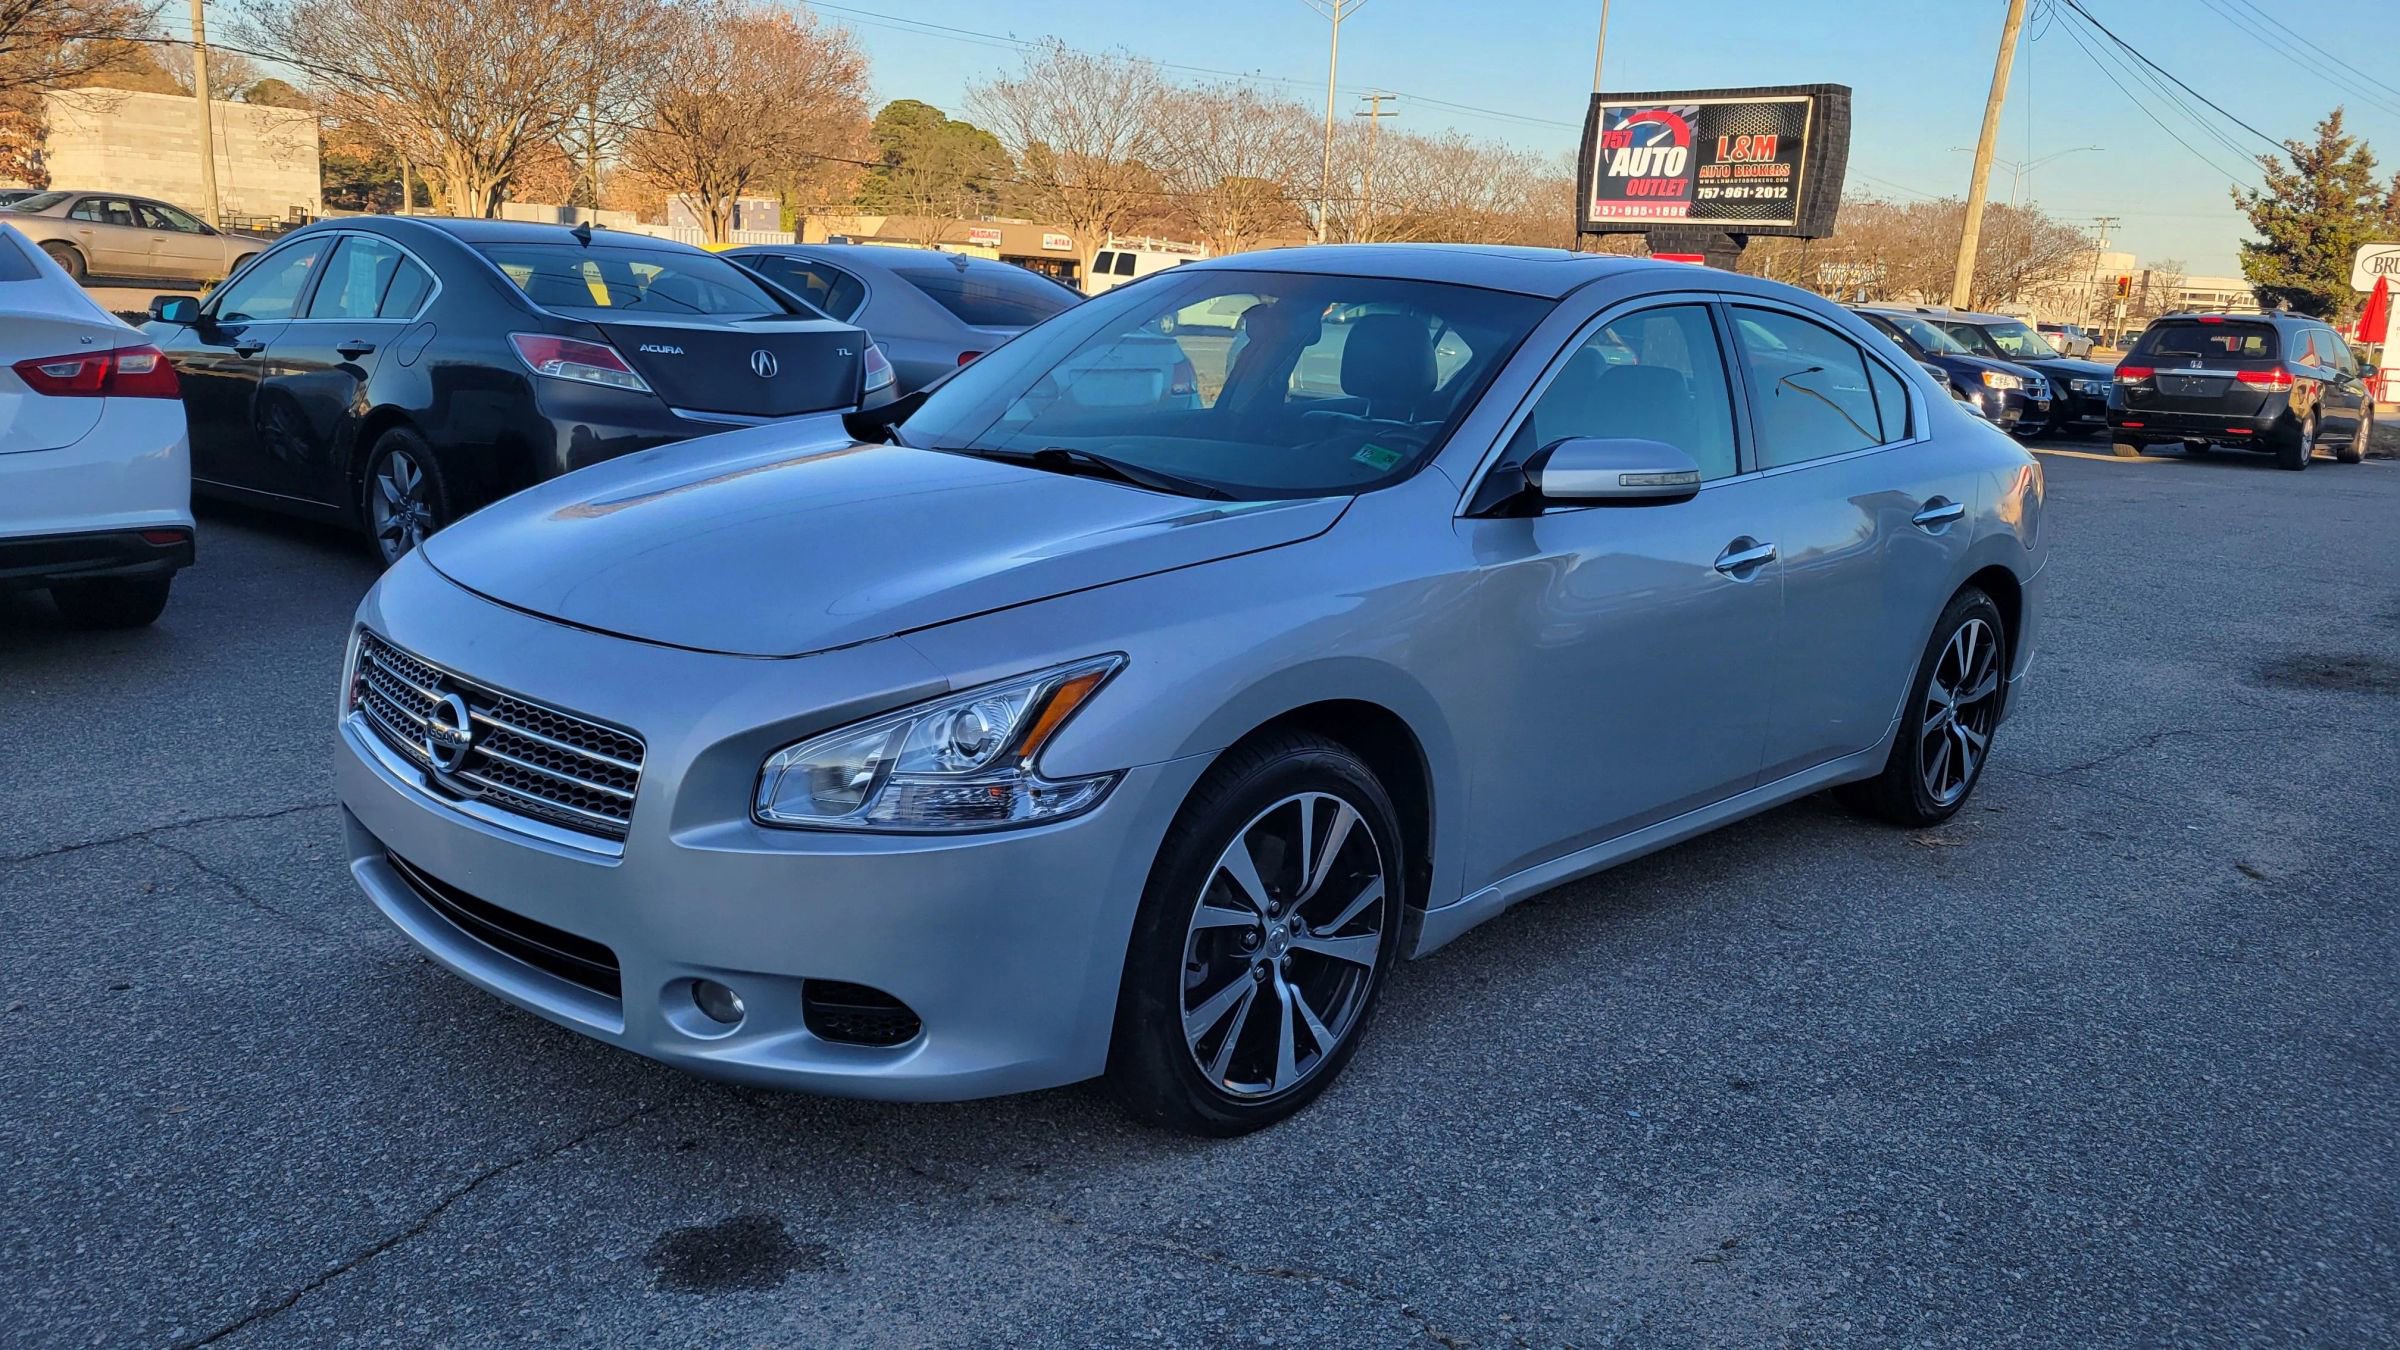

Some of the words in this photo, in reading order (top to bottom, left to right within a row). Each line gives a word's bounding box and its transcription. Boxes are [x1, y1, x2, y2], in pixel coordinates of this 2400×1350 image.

[1602, 130, 1632, 149] 757
[1716, 135, 1777, 163] L&M
[1608, 147, 1688, 177] AUTO
[1699, 166, 1731, 178] AUTO
[1734, 164, 1790, 178] BROKERS
[1626, 179, 1688, 196] OUTLET
[640, 343, 684, 355] ACURA
